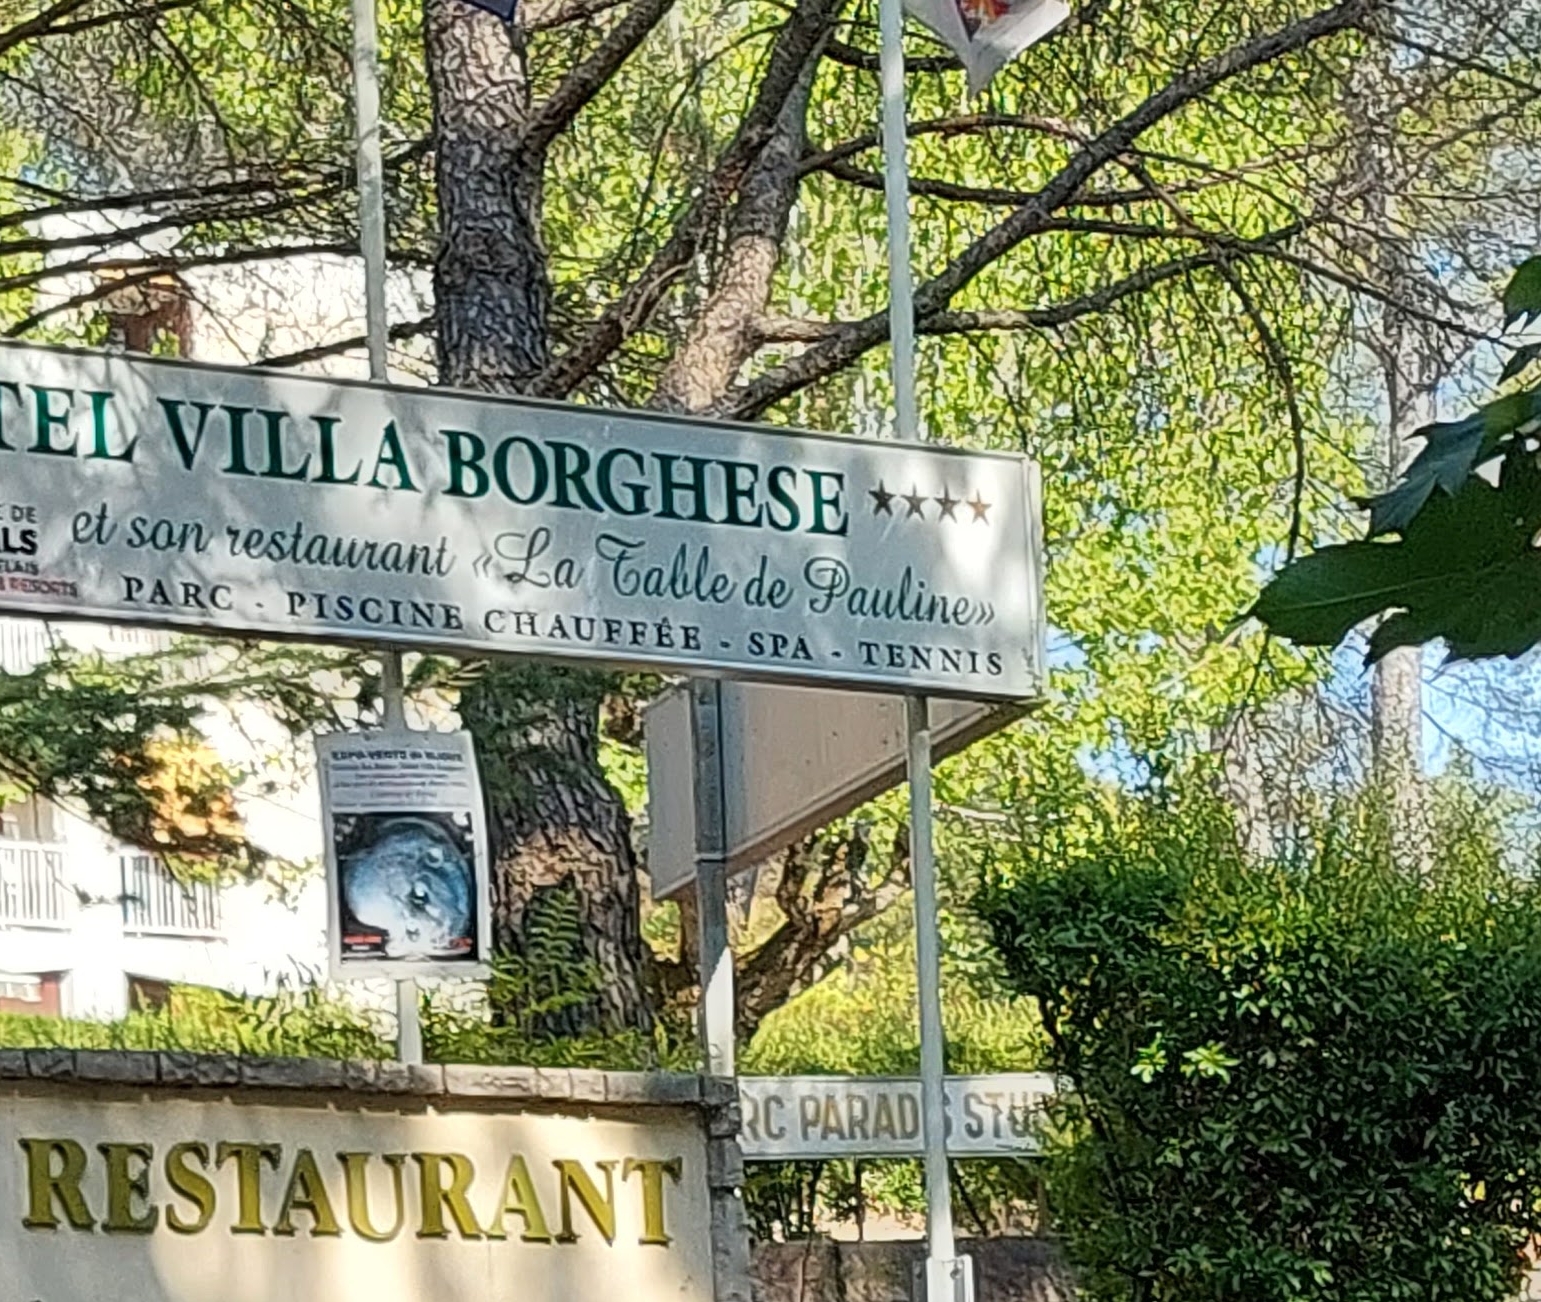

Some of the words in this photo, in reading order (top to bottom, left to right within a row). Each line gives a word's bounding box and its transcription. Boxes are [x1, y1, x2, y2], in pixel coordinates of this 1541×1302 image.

[10, 504, 38, 524] DE
[157, 395, 422, 492] VILLA
[439, 428, 849, 537] BORGHESE
[10, 578, 78, 598] RESORTS
[72, 502, 113, 545] et
[127, 518, 217, 554] son
[226, 524, 455, 577] restaurant
[595, 532, 735, 606] Table
[744, 554, 794, 610] de
[123, 575, 234, 612] PARC
[287, 590, 464, 631] PISCINE
[483, 608, 702, 652] CHAUFFÉE
[748, 632, 814, 662] SPA
[859, 641, 1004, 677] TENNIS
[18, 1136, 683, 1246] RESTAURANT
